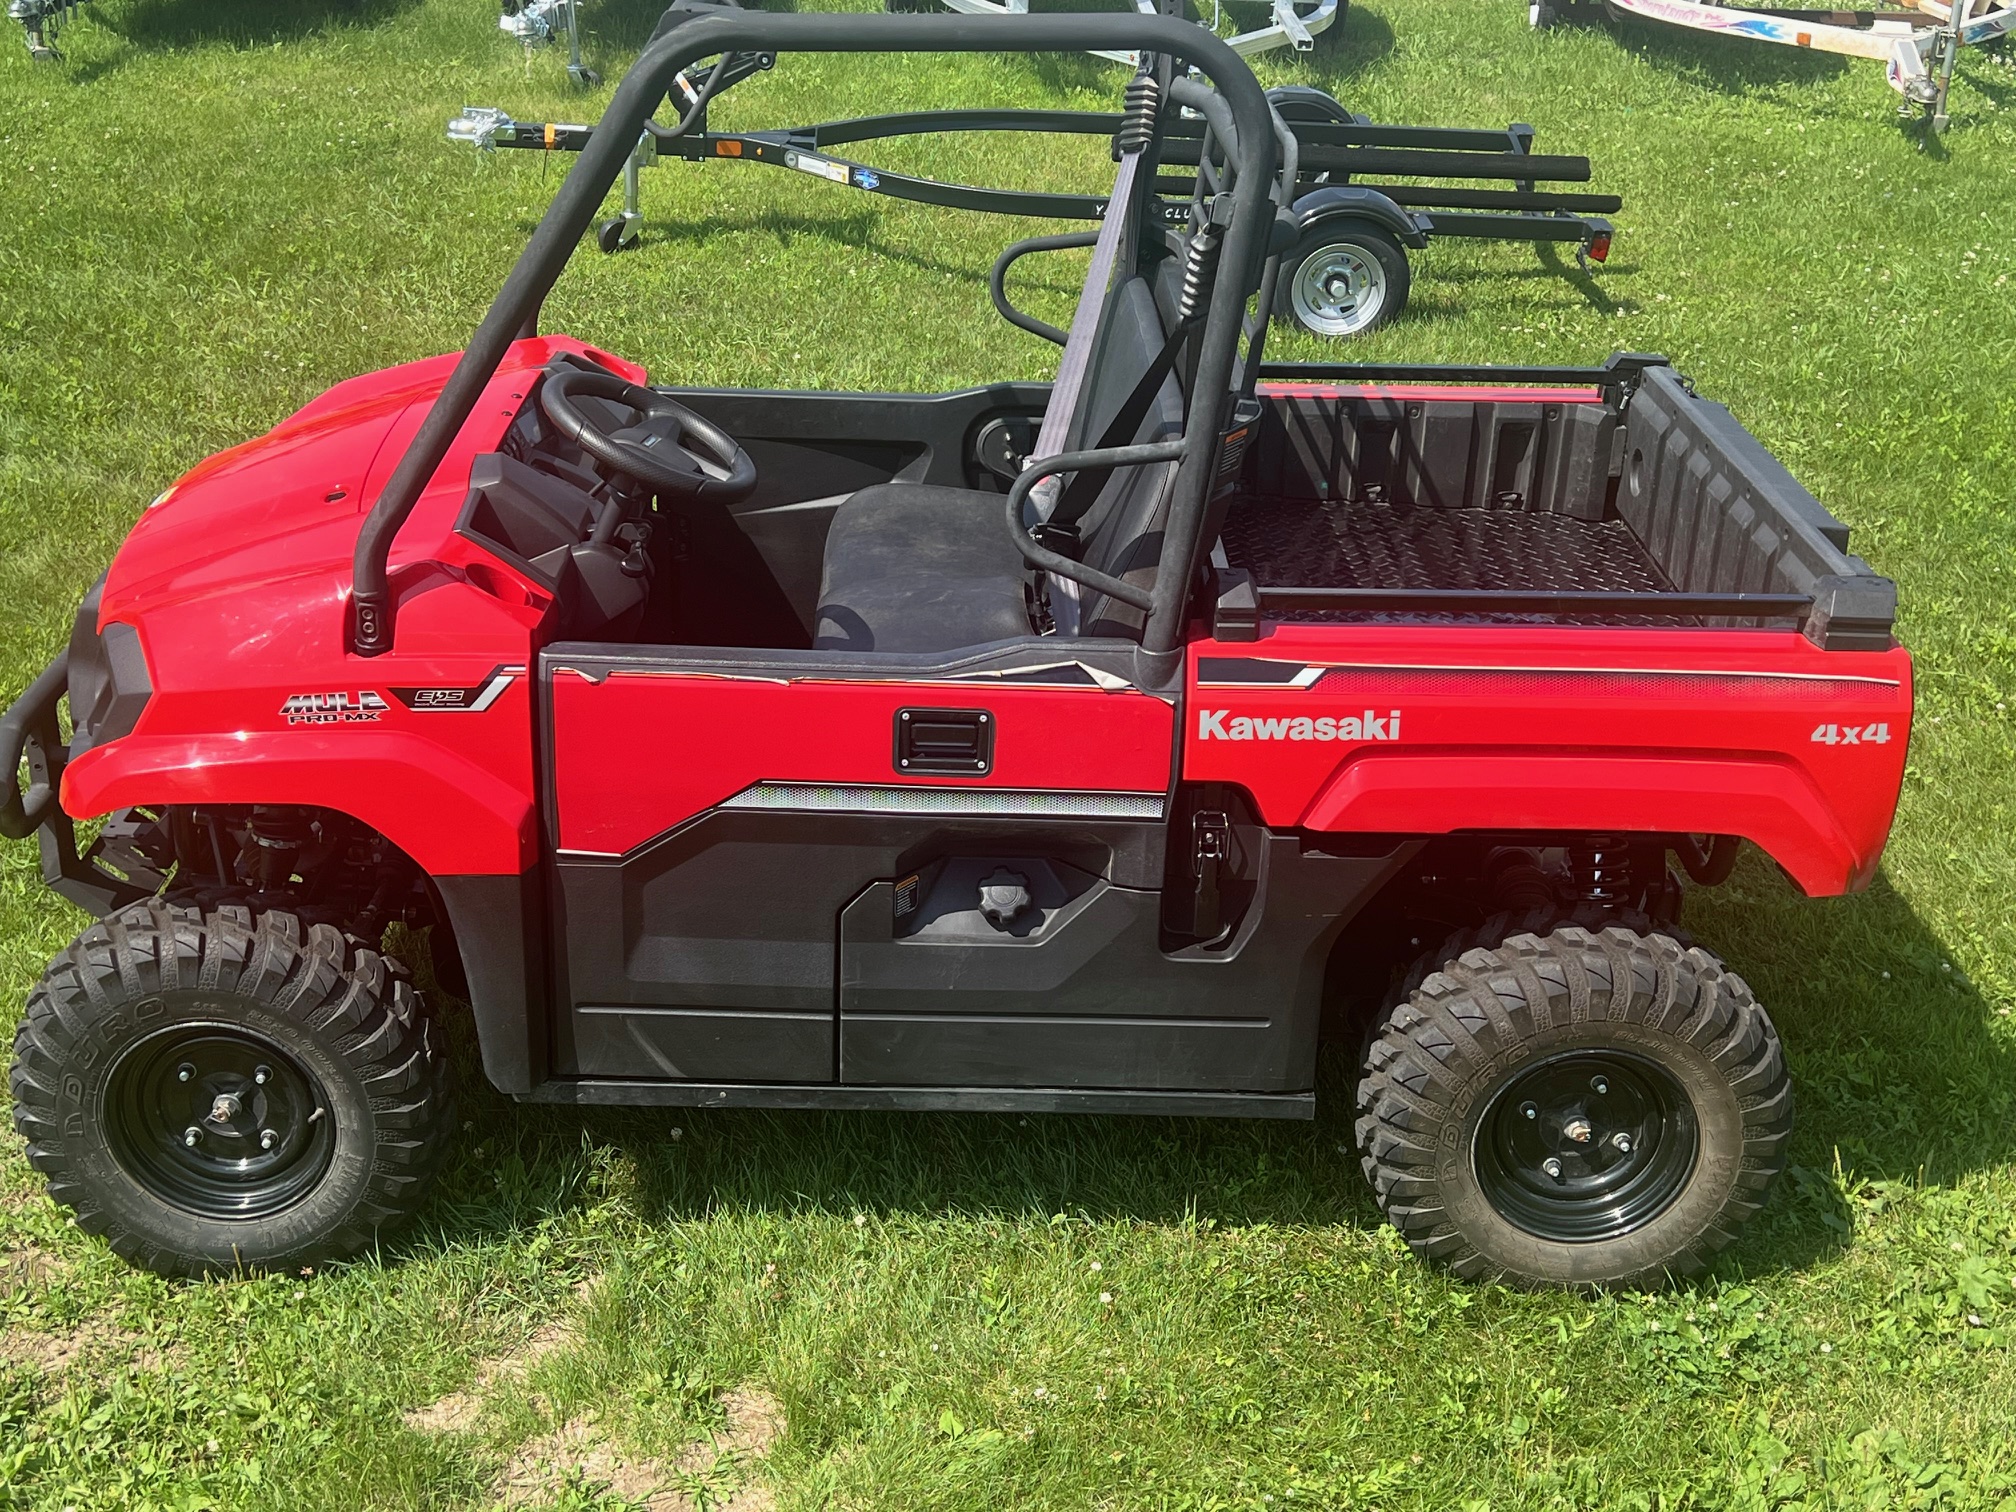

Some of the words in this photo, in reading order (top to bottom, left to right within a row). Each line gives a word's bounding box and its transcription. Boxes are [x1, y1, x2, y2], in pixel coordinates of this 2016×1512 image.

[1165, 207, 1192, 219] CLU
[279, 691, 390, 715] MULE
[415, 690, 464, 704] EPS
[288, 712, 380, 725] PRO-MX
[1199, 709, 1400, 741] Kawasaki
[1810, 722, 1891, 745] 4x4
